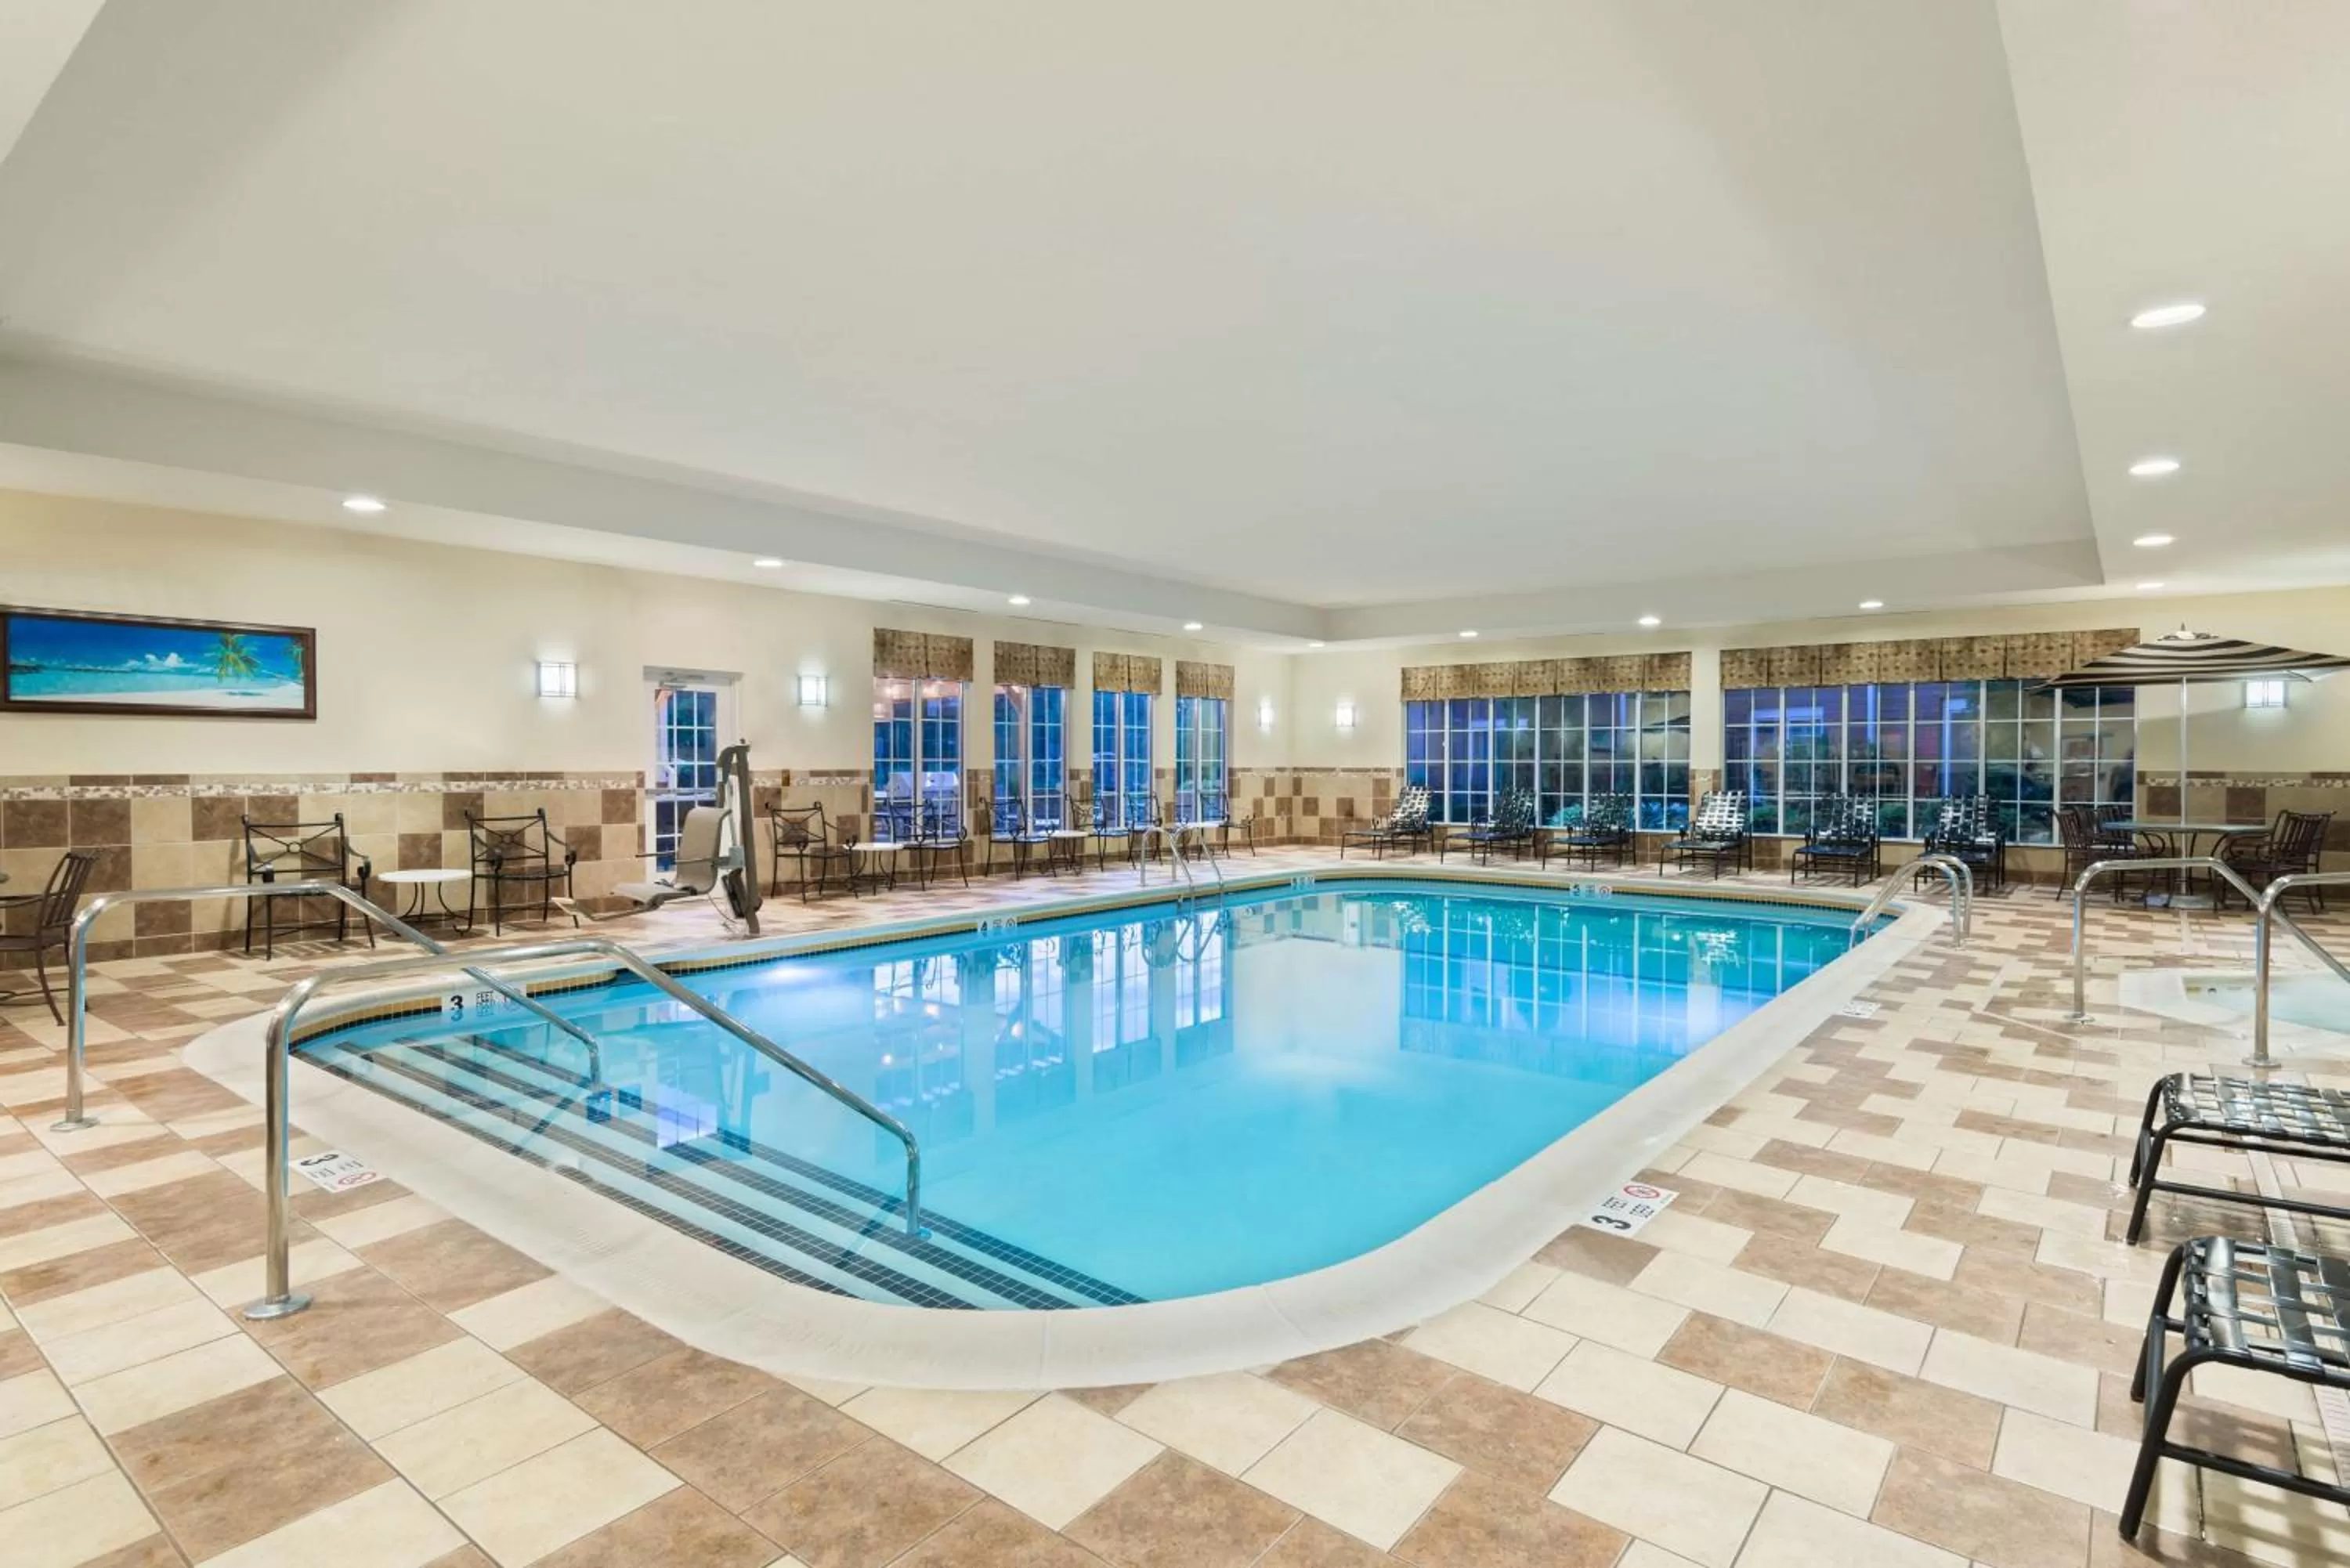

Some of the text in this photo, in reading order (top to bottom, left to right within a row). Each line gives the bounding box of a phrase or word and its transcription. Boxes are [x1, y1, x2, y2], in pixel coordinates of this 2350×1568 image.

[450, 994, 464, 1010] 3
[300, 1154, 339, 1166] 3
[1592, 1215, 1631, 1230] 3
